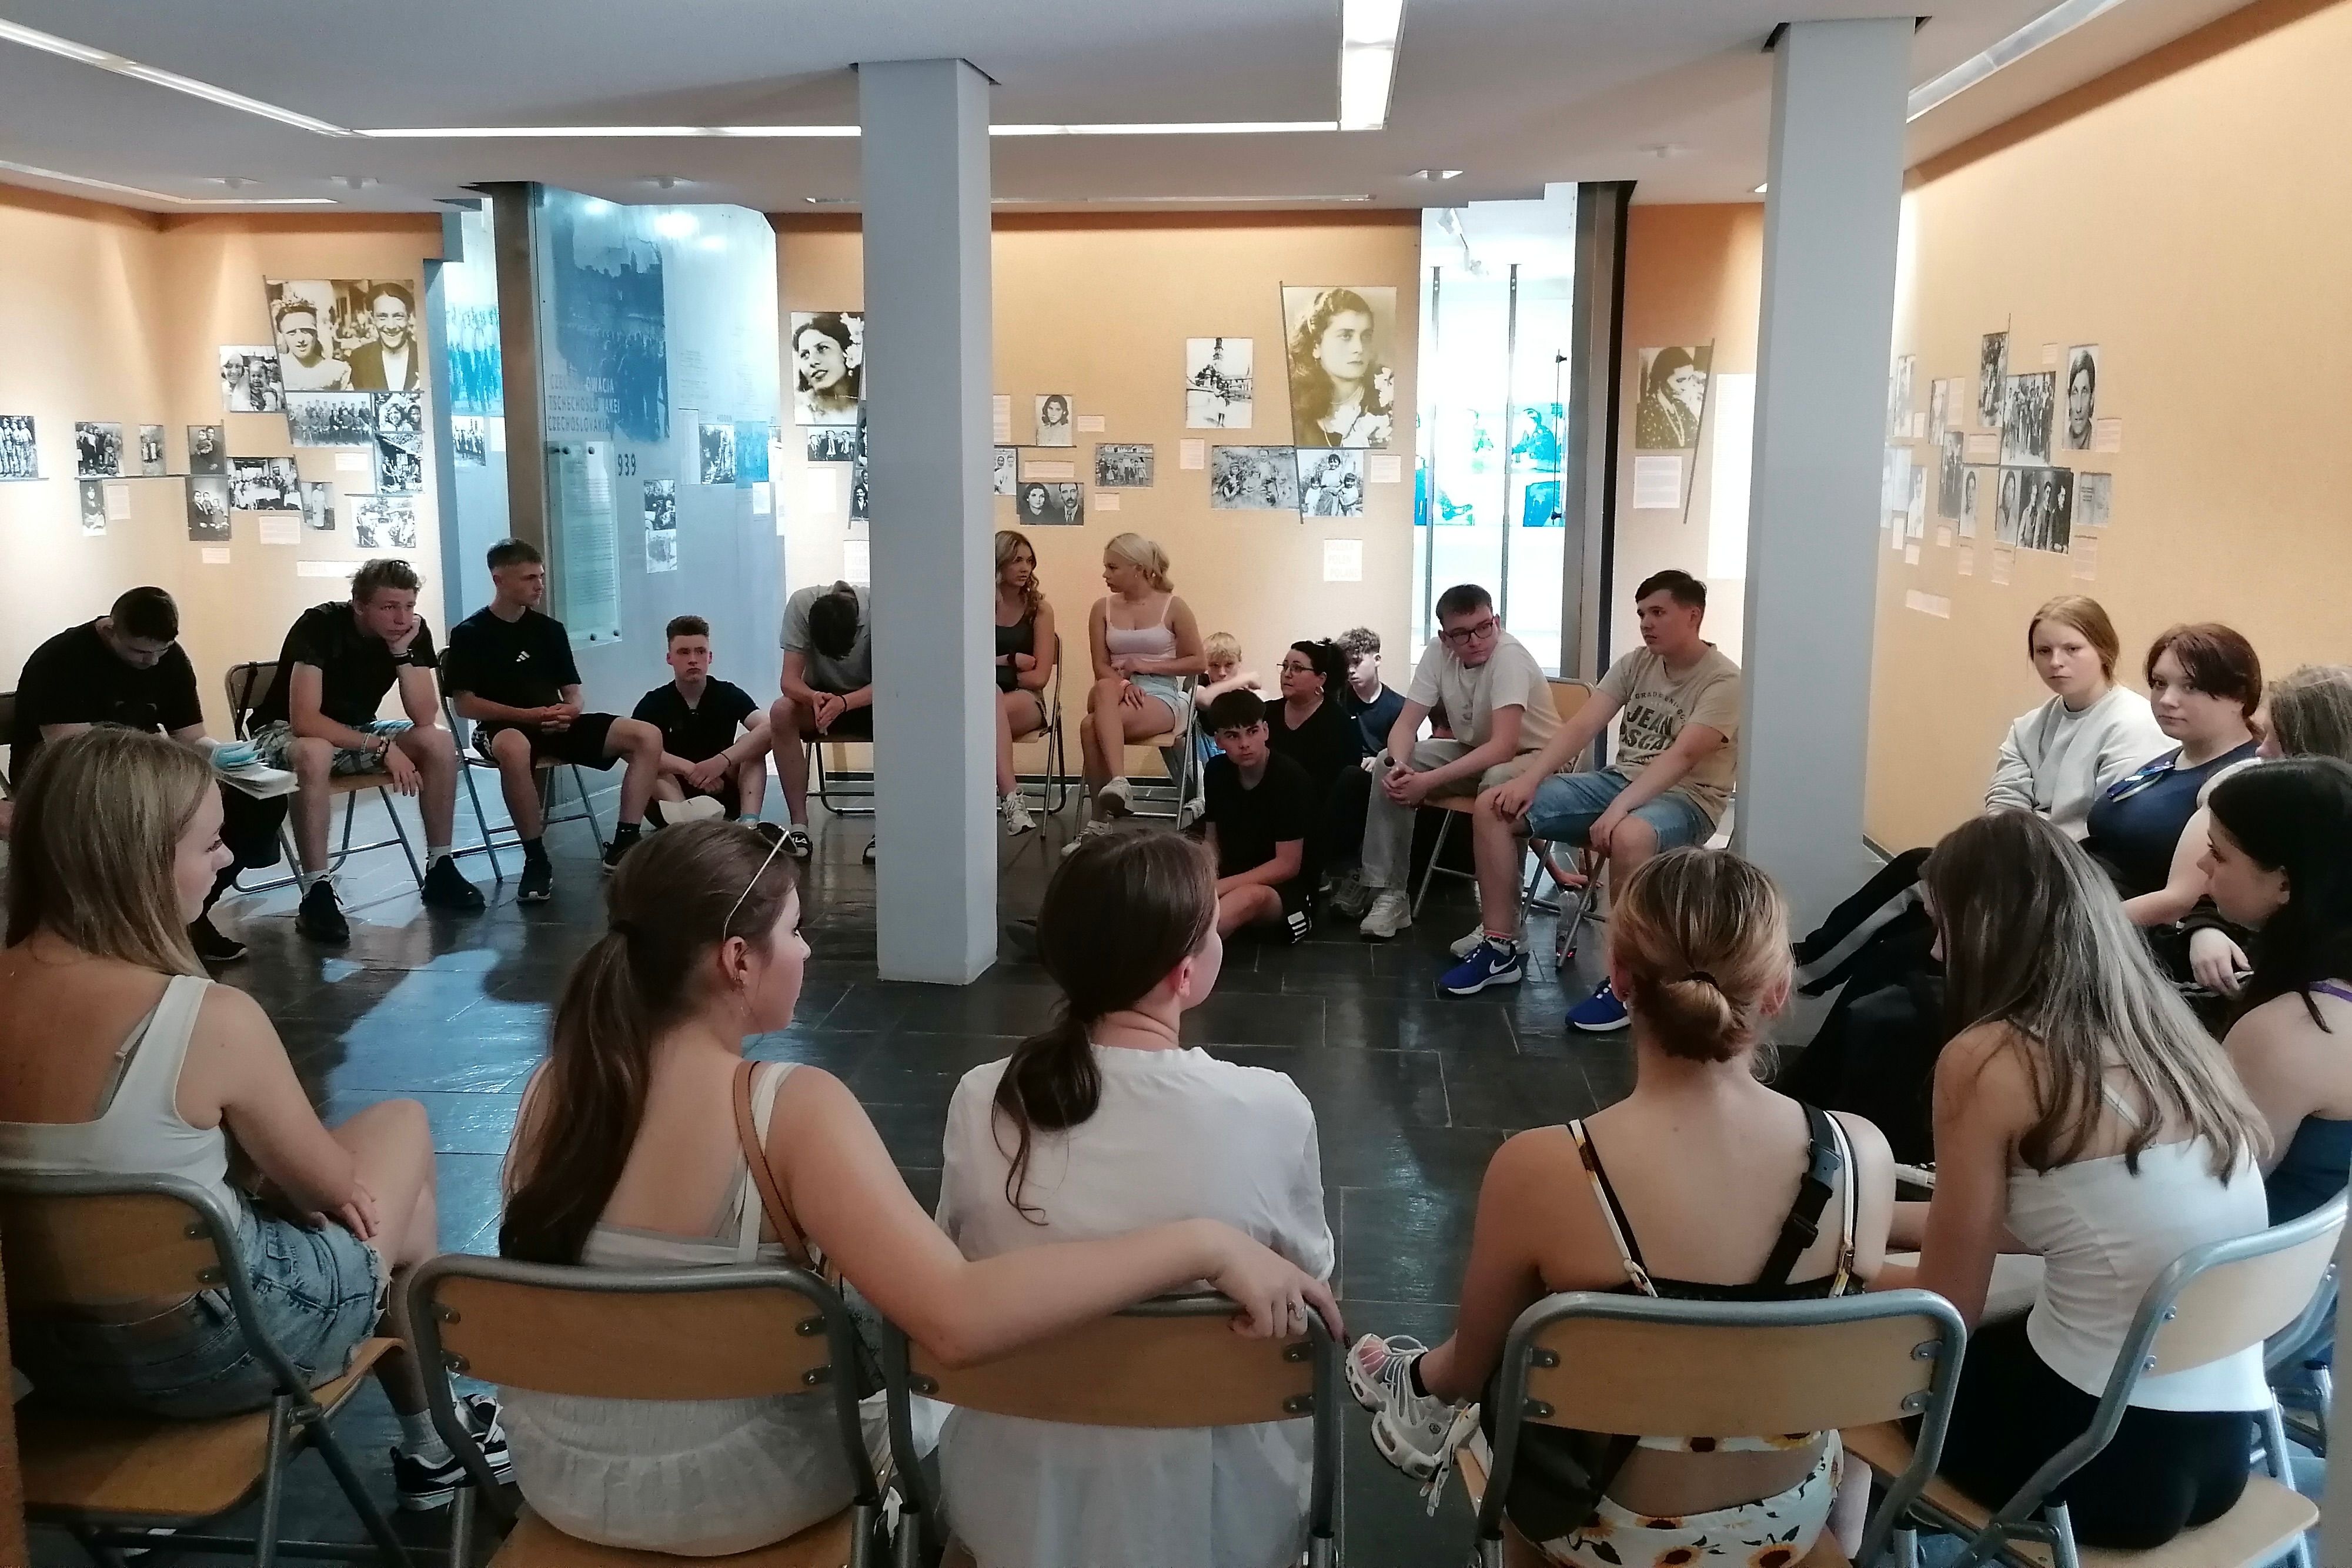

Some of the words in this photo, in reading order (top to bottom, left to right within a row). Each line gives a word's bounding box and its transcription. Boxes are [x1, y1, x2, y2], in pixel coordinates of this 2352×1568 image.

[549, 395, 620, 413] TSCHECHOSLOAKEI
[617, 454, 636, 476] 939
[1626, 705, 1673, 736] JEAN
